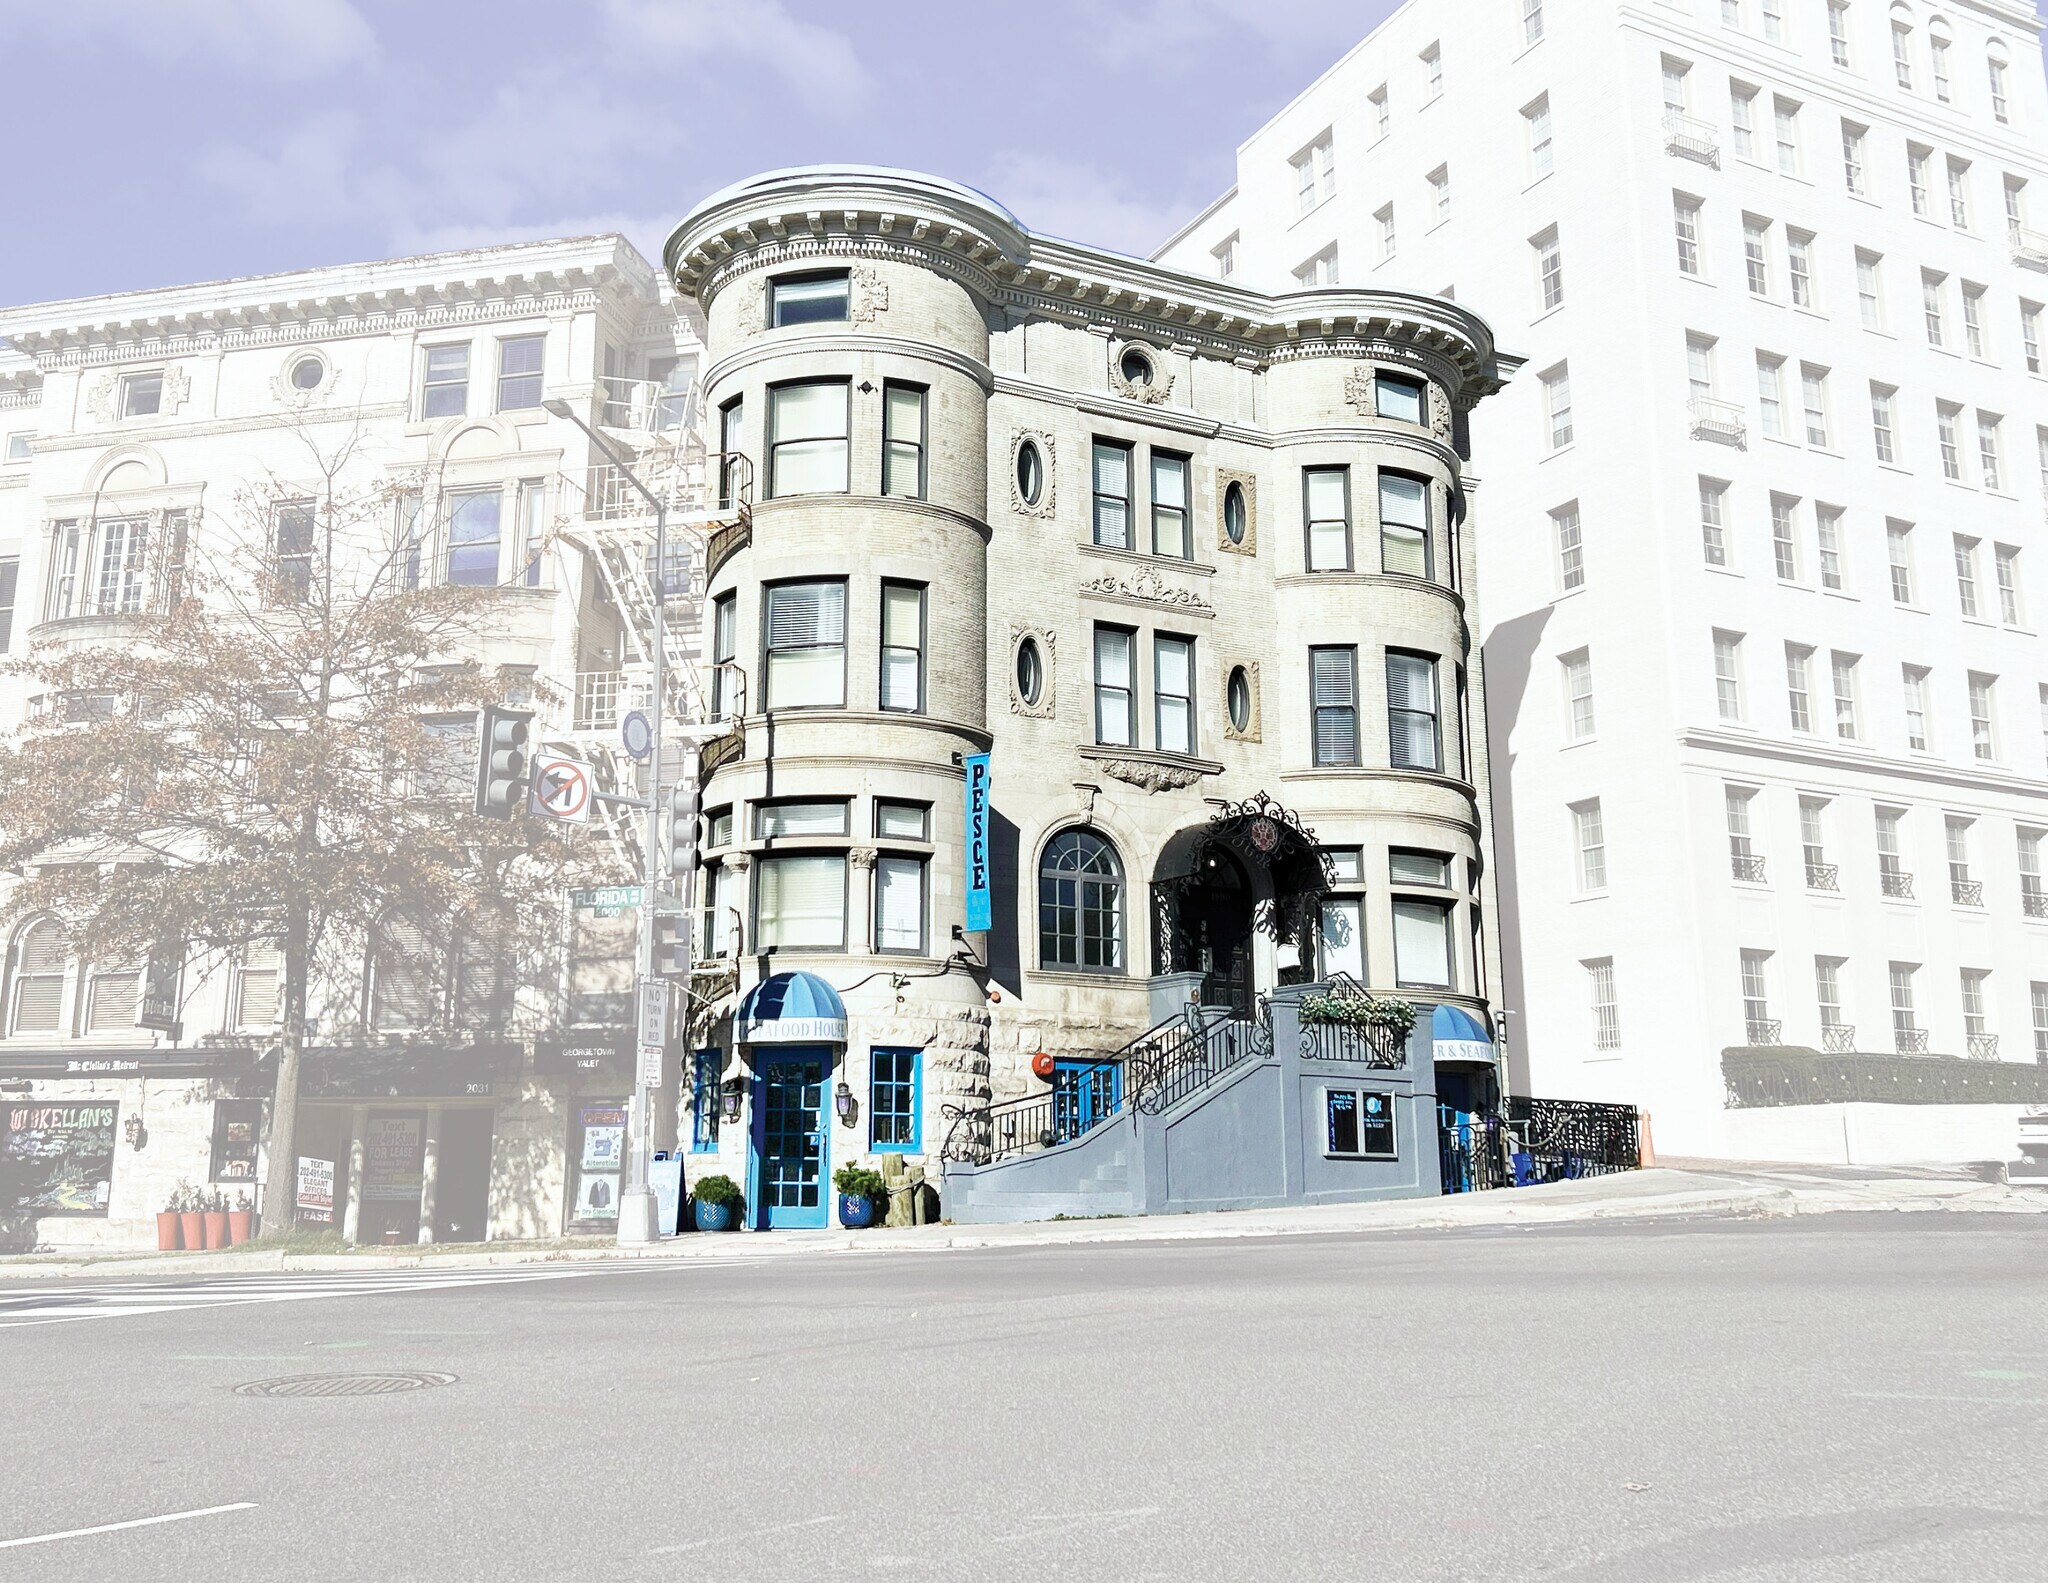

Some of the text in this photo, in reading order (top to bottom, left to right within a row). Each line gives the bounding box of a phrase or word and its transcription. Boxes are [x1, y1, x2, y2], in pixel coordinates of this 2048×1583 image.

[972, 763, 986, 891] PESCE
[575, 890, 629, 906] FLORIDA
[649, 990, 661, 1002] NO
[647, 1004, 662, 1015] TURN
[649, 1018, 658, 1028] ON
[648, 1031, 660, 1042] RED
[562, 1048, 616, 1057] GEORGETOWN
[1447, 1044, 1457, 1058] &
[577, 1059, 600, 1068] VALET
[466, 1083, 489, 1094] 2031
[583, 1111, 625, 1124] OPEN
[381, 1120, 407, 1131] Text
[369, 1147, 414, 1159] FOR LEASE
[310, 1160, 324, 1169] TEXT
[303, 1177, 328, 1188] ELEGANT
[304, 1185, 327, 1195] OFFICES
[298, 1210, 331, 1222] EASE
[581, 1208, 592, 1217] Dry
